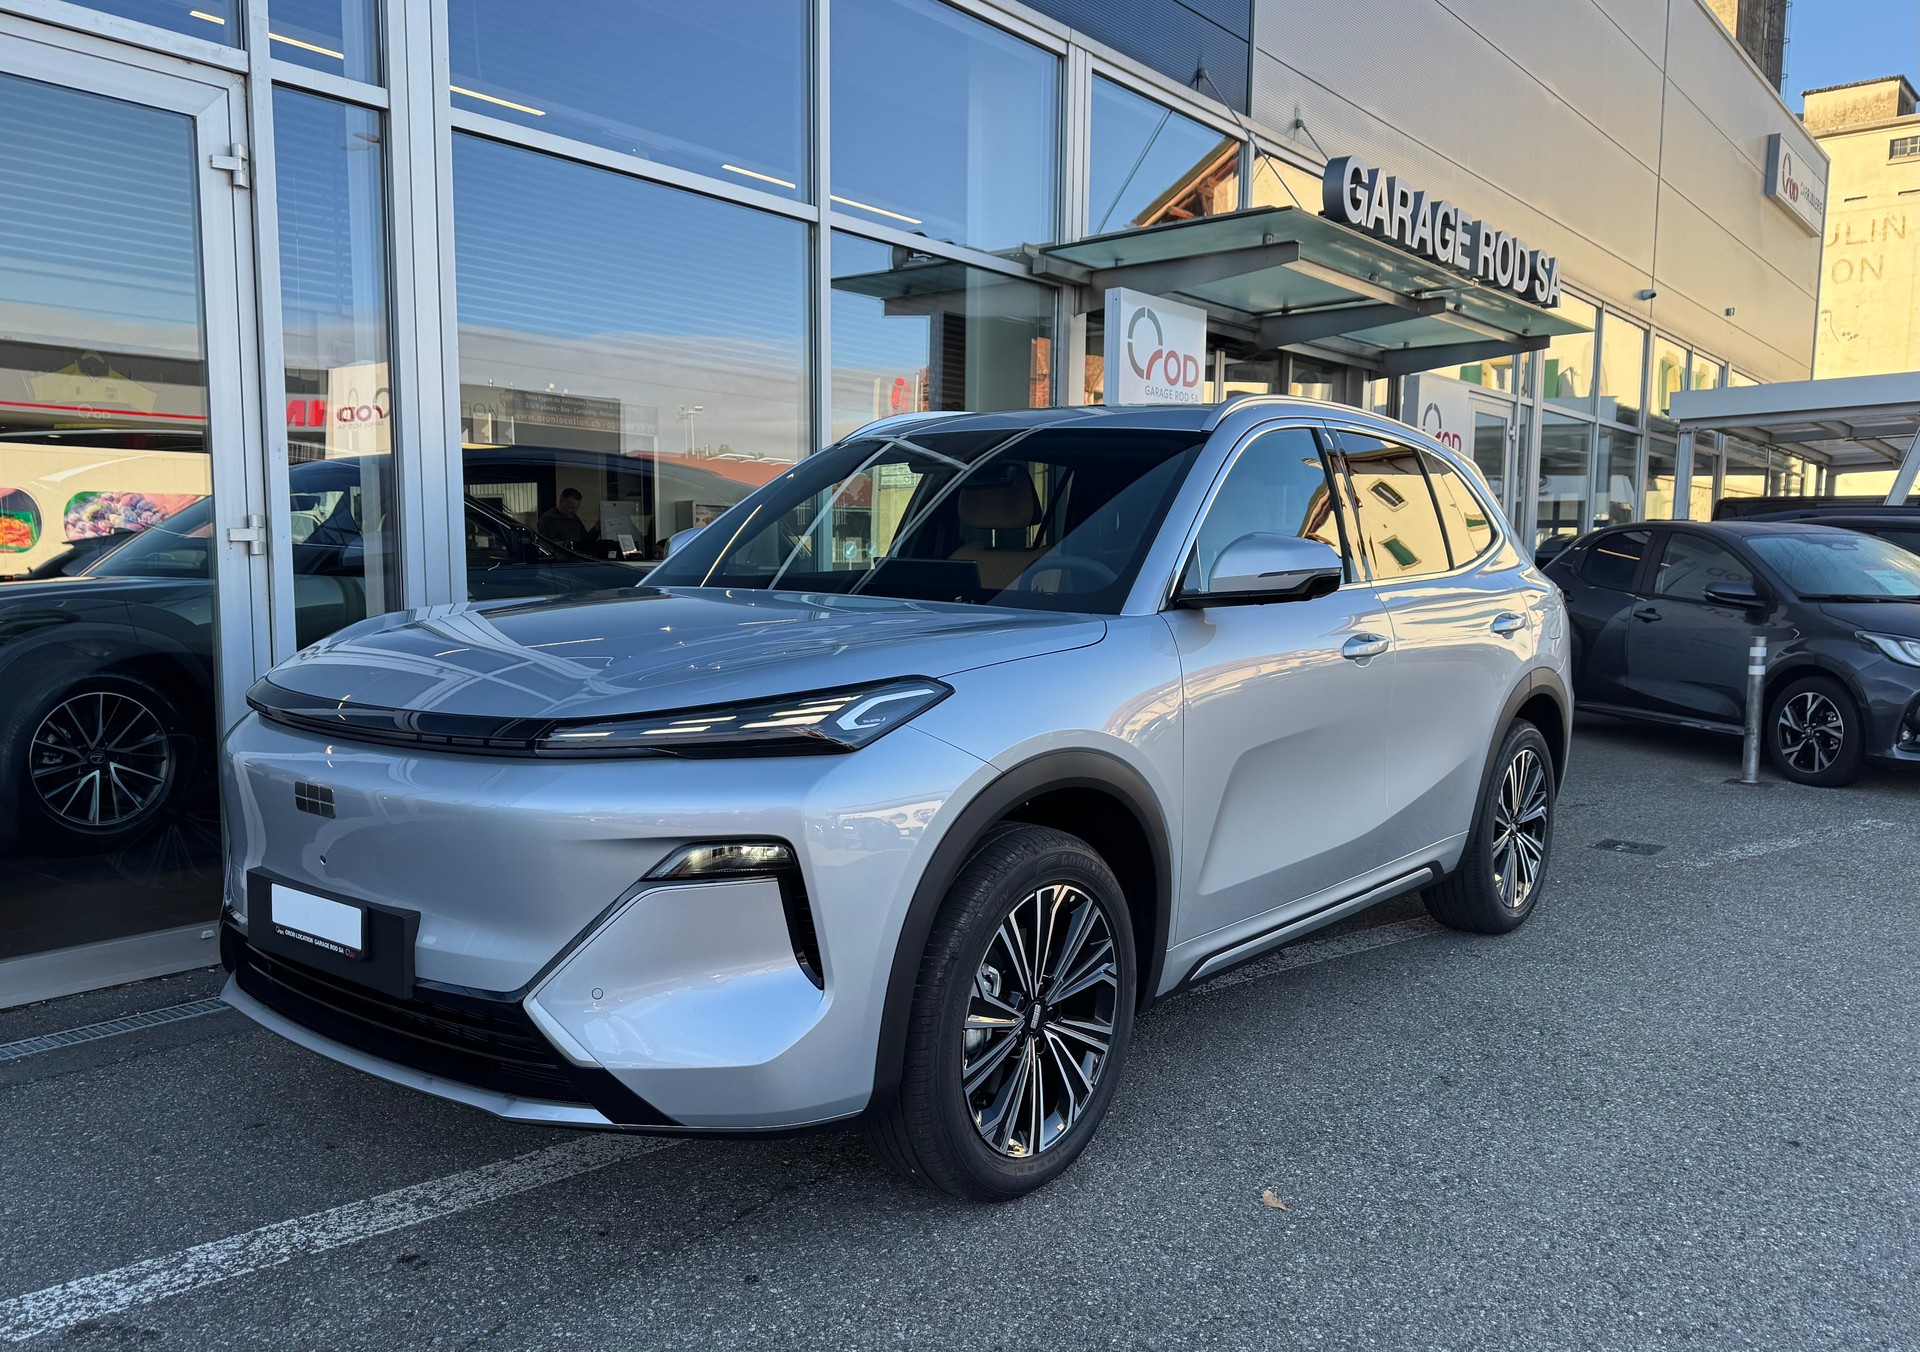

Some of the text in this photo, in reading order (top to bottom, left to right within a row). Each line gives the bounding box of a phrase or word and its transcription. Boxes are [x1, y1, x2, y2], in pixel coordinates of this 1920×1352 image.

[1342, 154, 1562, 309] GARAGE ROD SA
[1144, 384, 1173, 400] GARAGE
[1174, 390, 1190, 402] ROD
[513, 411, 602, 429] www.oronlocation.ch
[284, 929, 295, 938] ORON
[296, 933, 314, 944] LOCATION
[314, 939, 330, 950] GARAGE
[330, 944, 338, 952] ROD
